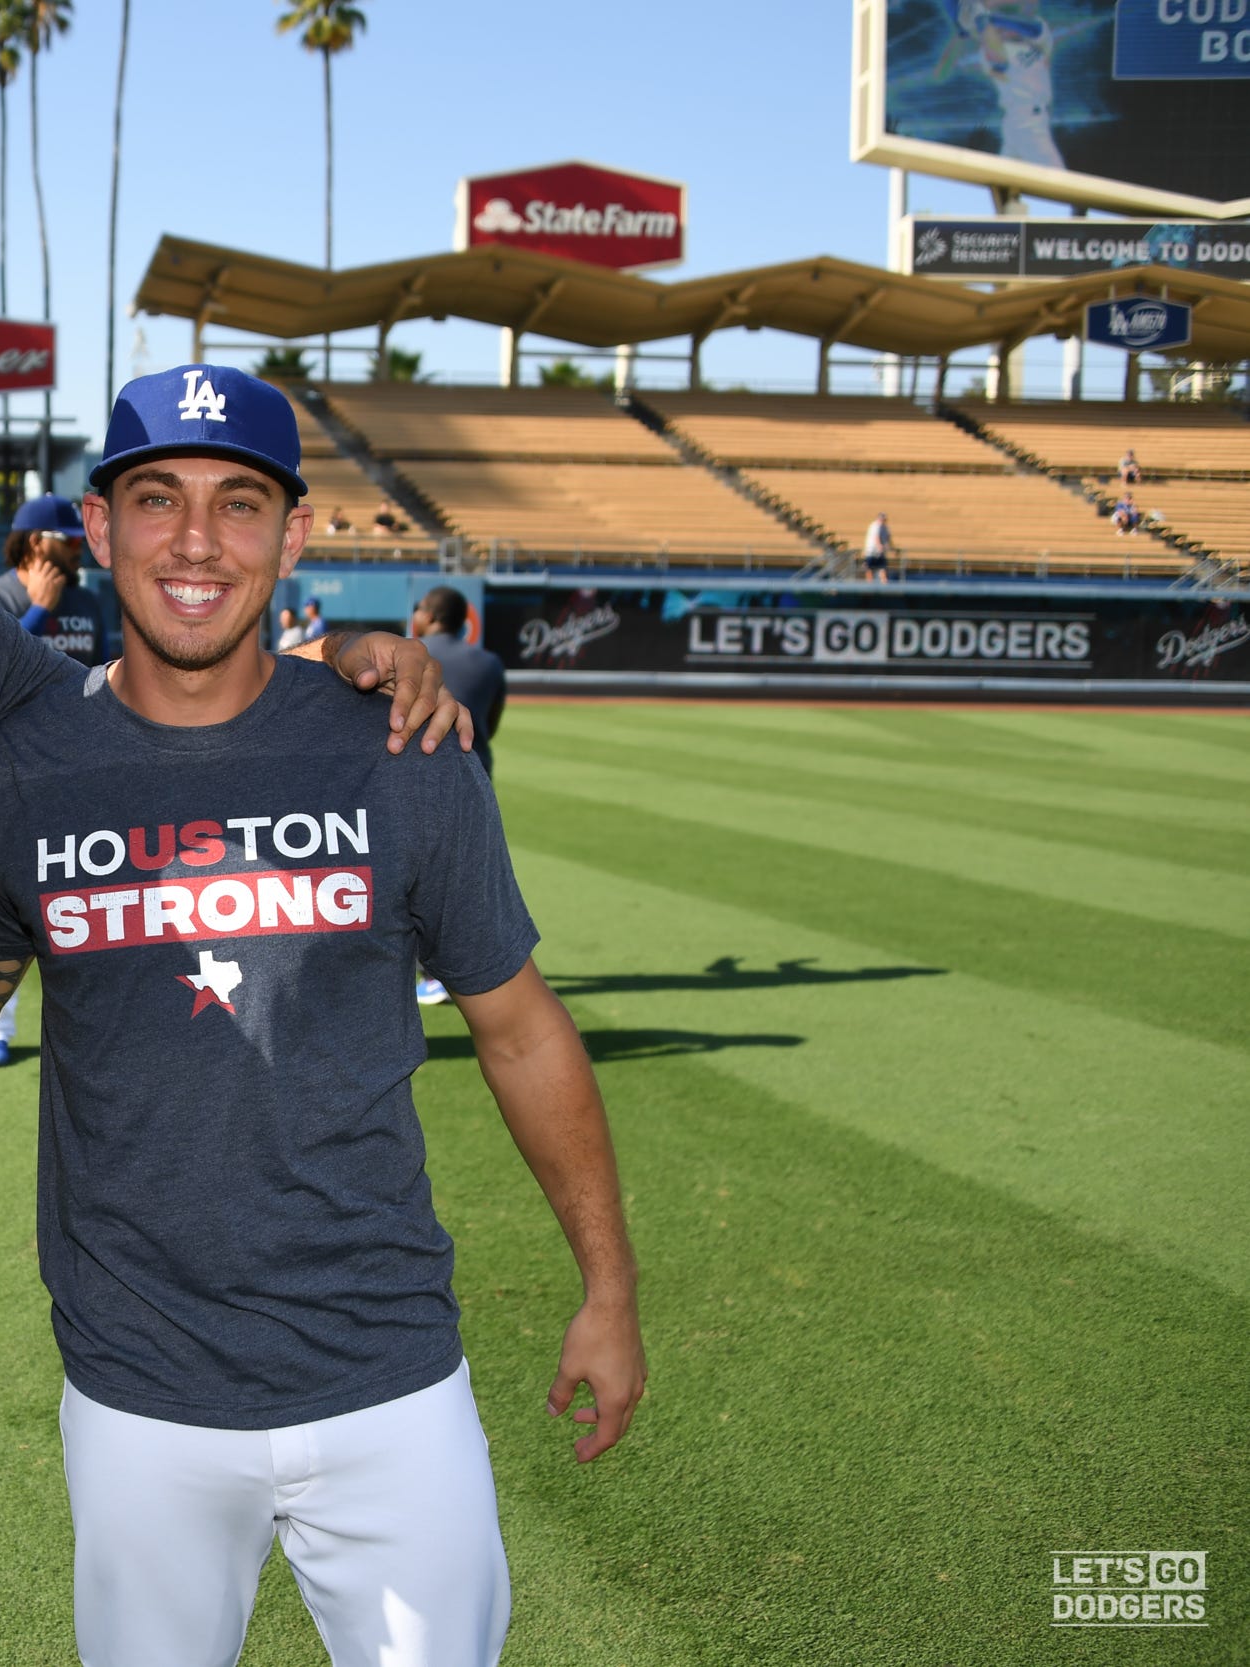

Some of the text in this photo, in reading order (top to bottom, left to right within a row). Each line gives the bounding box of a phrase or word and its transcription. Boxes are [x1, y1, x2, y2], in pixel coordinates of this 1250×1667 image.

[952, 231, 1019, 249] SECURITY
[952, 249, 1011, 263] BENEFIT
[1034, 238, 1150, 261] WELCOME
[1160, 243, 1188, 261] TO
[178, 370, 227, 422] LA
[518, 602, 621, 659] Dodgers
[688, 615, 1091, 660] LET'S GO DODGERS
[37, 809, 369, 882] HOUSTON
[46, 872, 367, 949] STRONG
